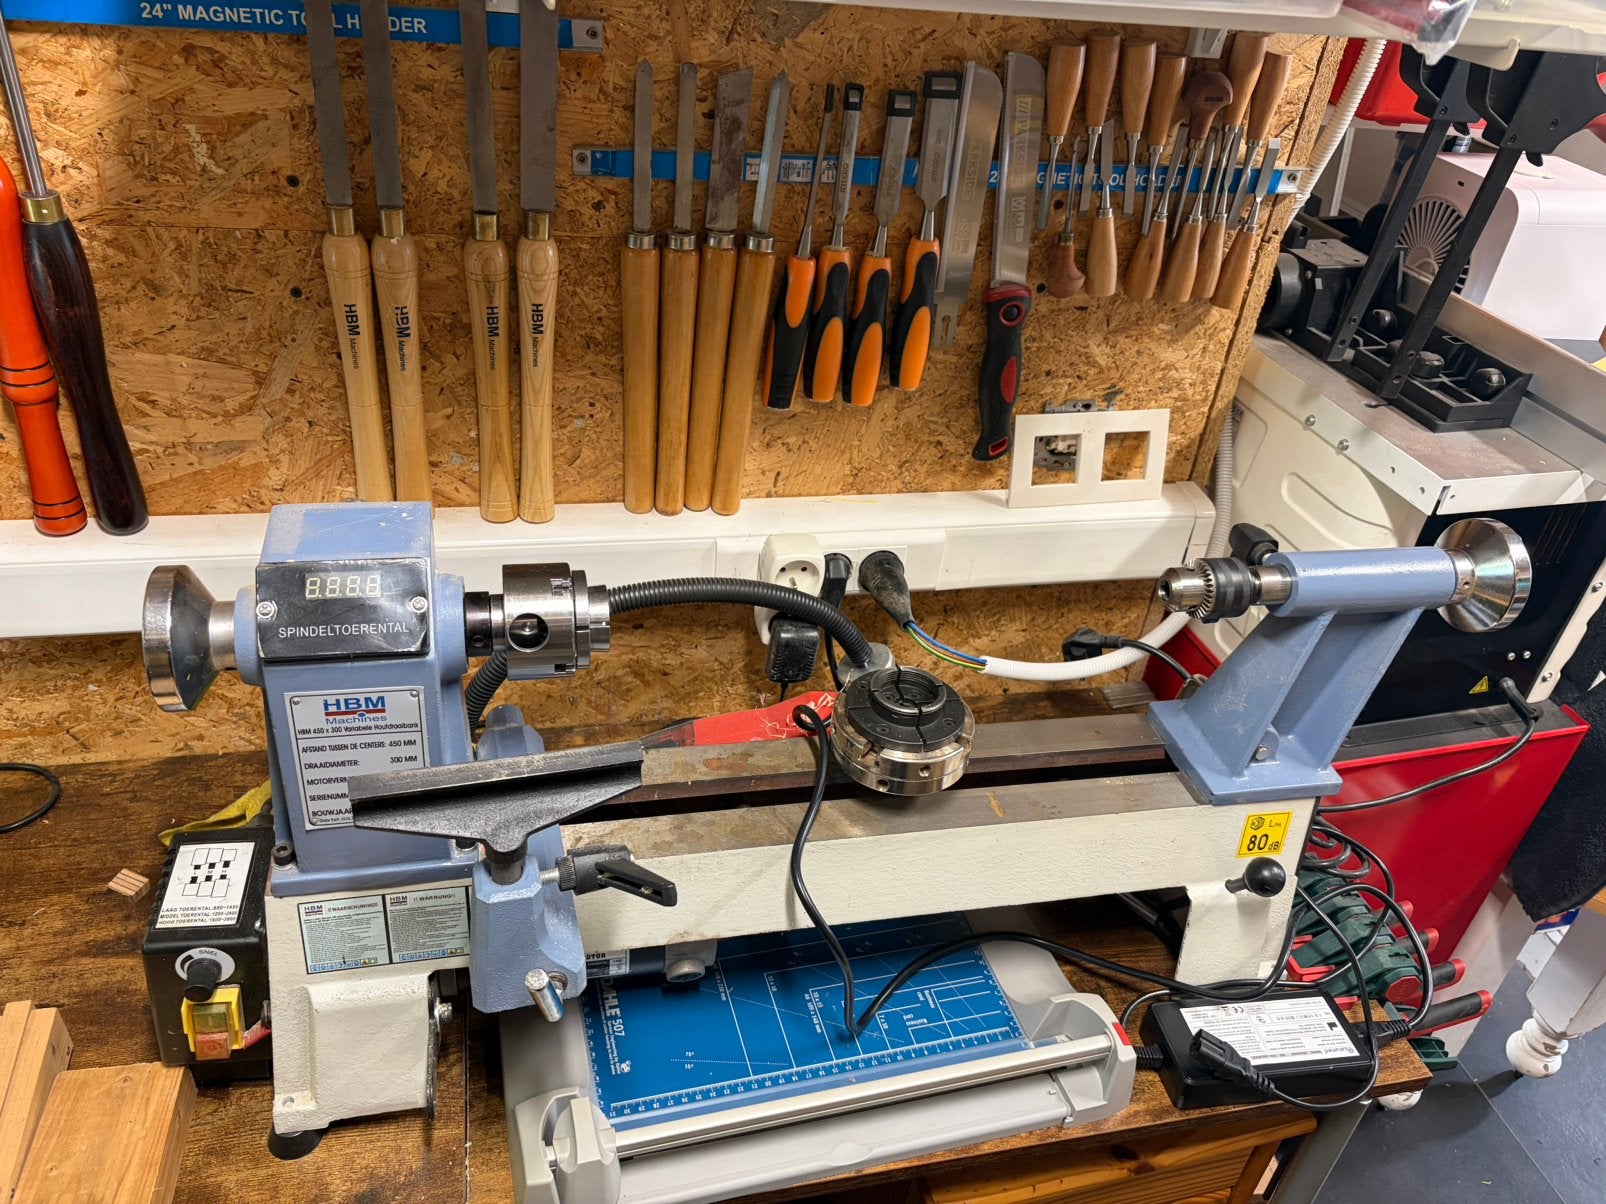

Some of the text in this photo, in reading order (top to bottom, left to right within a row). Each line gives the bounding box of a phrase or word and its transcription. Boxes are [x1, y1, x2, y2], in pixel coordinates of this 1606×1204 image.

[140, 3, 427, 34] 24" MAGNETIC TL HDER
[343, 304, 360, 336] HBM
[486, 306, 499, 337] HBM
[531, 303, 544, 334] HBM
[278, 622, 410, 639] SPINDELTOERENTAL
[323, 696, 386, 711] HBM
[326, 715, 388, 725] Machines
[344, 725, 373, 733] Variabele
[302, 745, 327, 754] AFSTAND
[328, 743, 348, 751] TUSSEN
[360, 741, 387, 749] CENTERS:
[304, 760, 360, 770] DRAAIDIAMETER:
[404, 755, 418, 763] MM
[1247, 834, 1279, 851] 80 dB
[613, 1019, 625, 1036] 507
